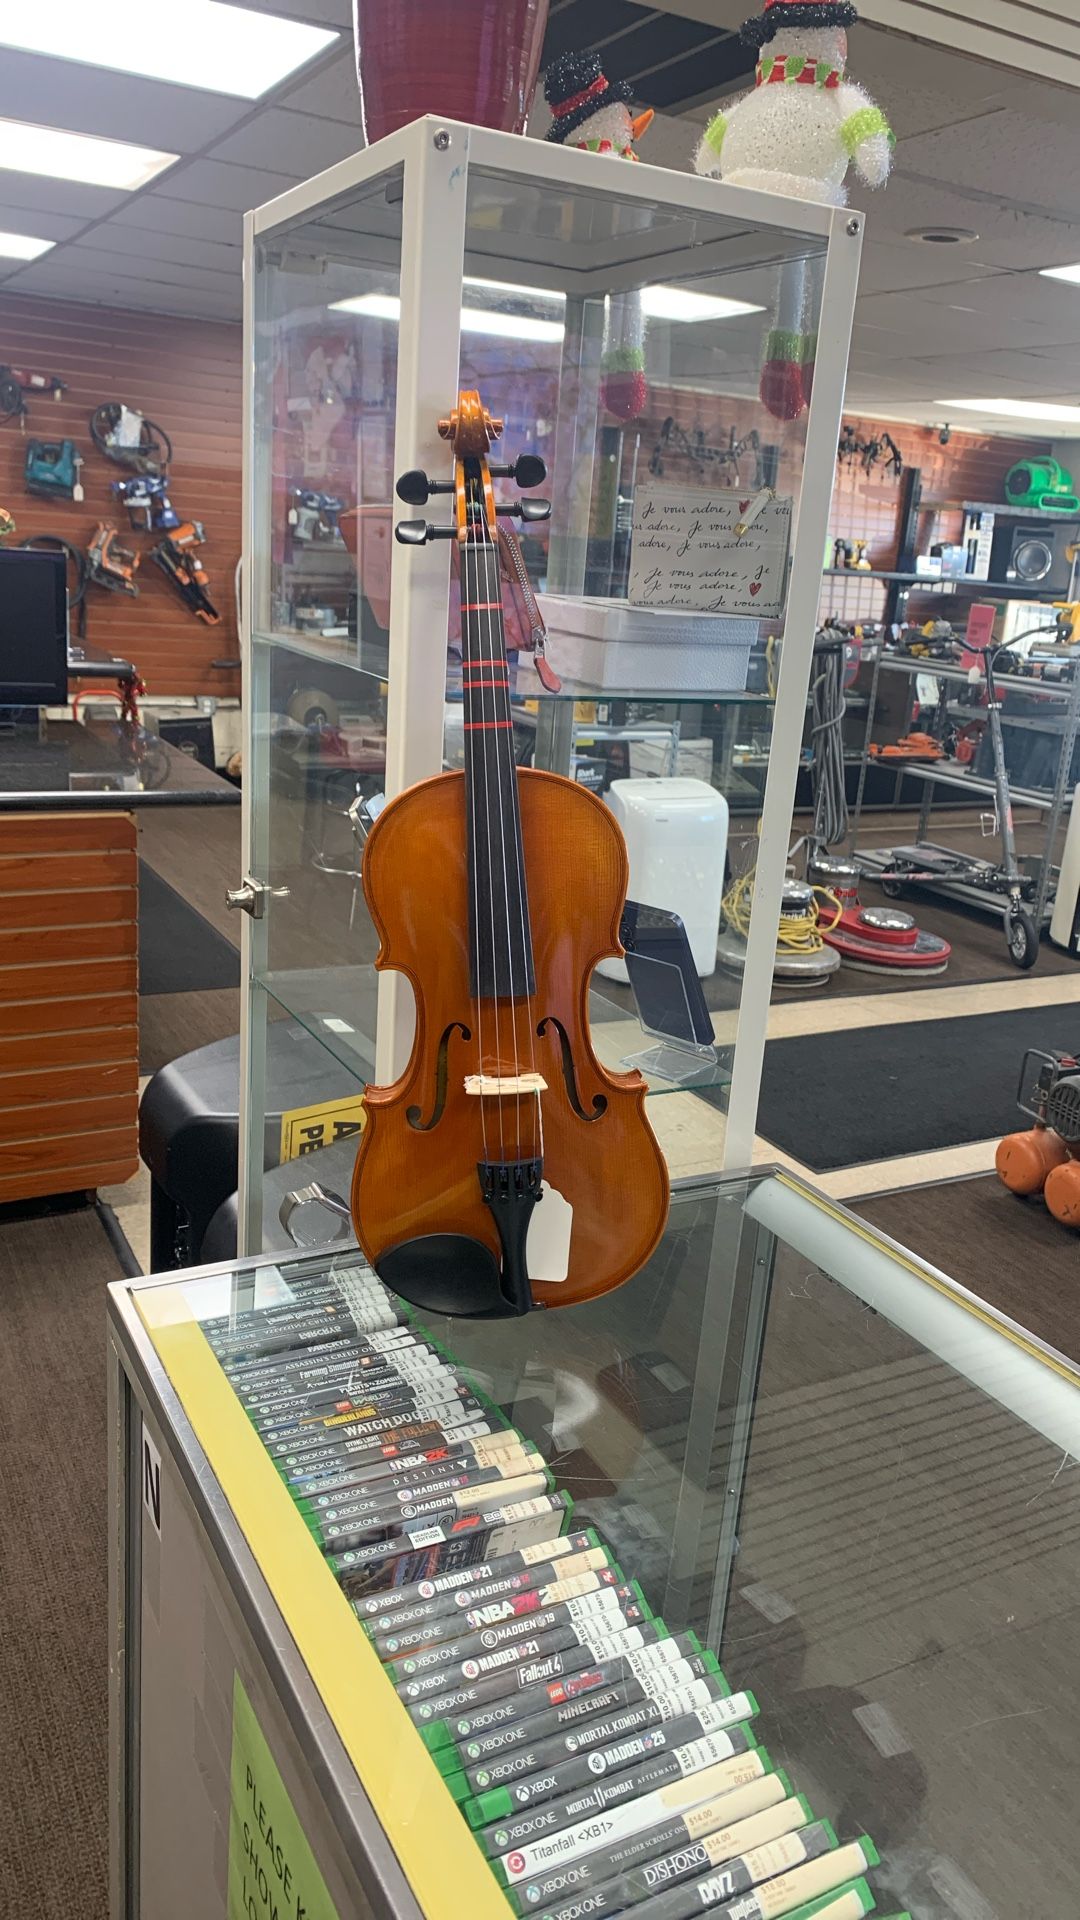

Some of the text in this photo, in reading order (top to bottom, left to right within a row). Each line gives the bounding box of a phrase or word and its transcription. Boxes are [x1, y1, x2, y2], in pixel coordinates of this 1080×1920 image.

[642, 502, 656, 518] Je
[690, 503, 731, 516] adore,
[639, 536, 760, 556] adore, Je vous adore,
[688, 522, 703, 538] Je
[644, 565, 770, 584] Je vous adore, Je
[644, 580, 661, 597] Je
[708, 596, 723, 610] Je
[300, 1366, 328, 1380] Farming
[288, 1440, 308, 1449] XBOX
[308, 1436, 326, 1444] ONE
[298, 1452, 318, 1462] XBOX
[319, 1448, 336, 1457] ONE
[305, 1459, 343, 1472] XBOX ONE
[318, 1478, 339, 1488] XBOX
[340, 1474, 358, 1482] ONE
[397, 1454, 426, 1470] NBA
[330, 1464, 454, 1502] XBOX ONE DESTINY
[338, 1480, 450, 1516] XBOX ONE MADDEN
[341, 1520, 362, 1532] XBOX
[363, 1517, 382, 1527] ONE
[416, 1497, 454, 1513] MADDEN
[356, 1546, 378, 1558] XBOX
[379, 1542, 396, 1552] ONE
[379, 1565, 492, 1608] XBOX MADDEN 21
[392, 1610, 416, 1624] XBOX
[416, 1605, 435, 1618] ONE
[471, 1580, 511, 1599] MADDEN
[400, 1632, 423, 1646] XBOX
[423, 1626, 442, 1639] ONE
[472, 1600, 514, 1627] NBA
[416, 1612, 556, 1668] XBOX ONE MADDEN 19
[420, 1640, 540, 1690] XBOX MADDEN 21
[432, 1697, 458, 1712] XBOX
[458, 1690, 478, 1704] ONE
[520, 1662, 554, 1685] Fallout
[552, 1656, 562, 1673] 4
[471, 1714, 495, 1730] XBOX
[495, 1706, 516, 1720] ONE
[480, 1691, 620, 1752] XBOX ONE MINECRAFT
[490, 1764, 515, 1780] XBOX
[515, 1754, 538, 1771] ONE
[578, 1722, 614, 1746] MORTAL
[612, 1710, 646, 1732] KOMBAT
[530, 1730, 666, 1795] XBOX MADDEN 25
[508, 1822, 534, 1840] XBOX
[534, 1812, 558, 1829] ONE
[566, 1796, 597, 1816] MORTAL
[604, 1780, 634, 1800] KOMBAT
[637, 1764, 679, 1785] AFTERMATH
[688, 1809, 713, 1826] $14.00
[246, 1764, 292, 1904] PLEASE
[530, 1822, 614, 1861] Titanfall <XB1>
[706, 1832, 732, 1848] $14.00
[541, 1876, 568, 1895] XBOX
[568, 1866, 592, 1883] ONE
[609, 1853, 624, 1864] THE
[624, 1844, 644, 1858] ELDER
[644, 1832, 673, 1847] SCROLLS
[556, 1904, 582, 1920] XBOX
[582, 1894, 608, 1912] ONE
[643, 1845, 707, 1886] DISHONO
